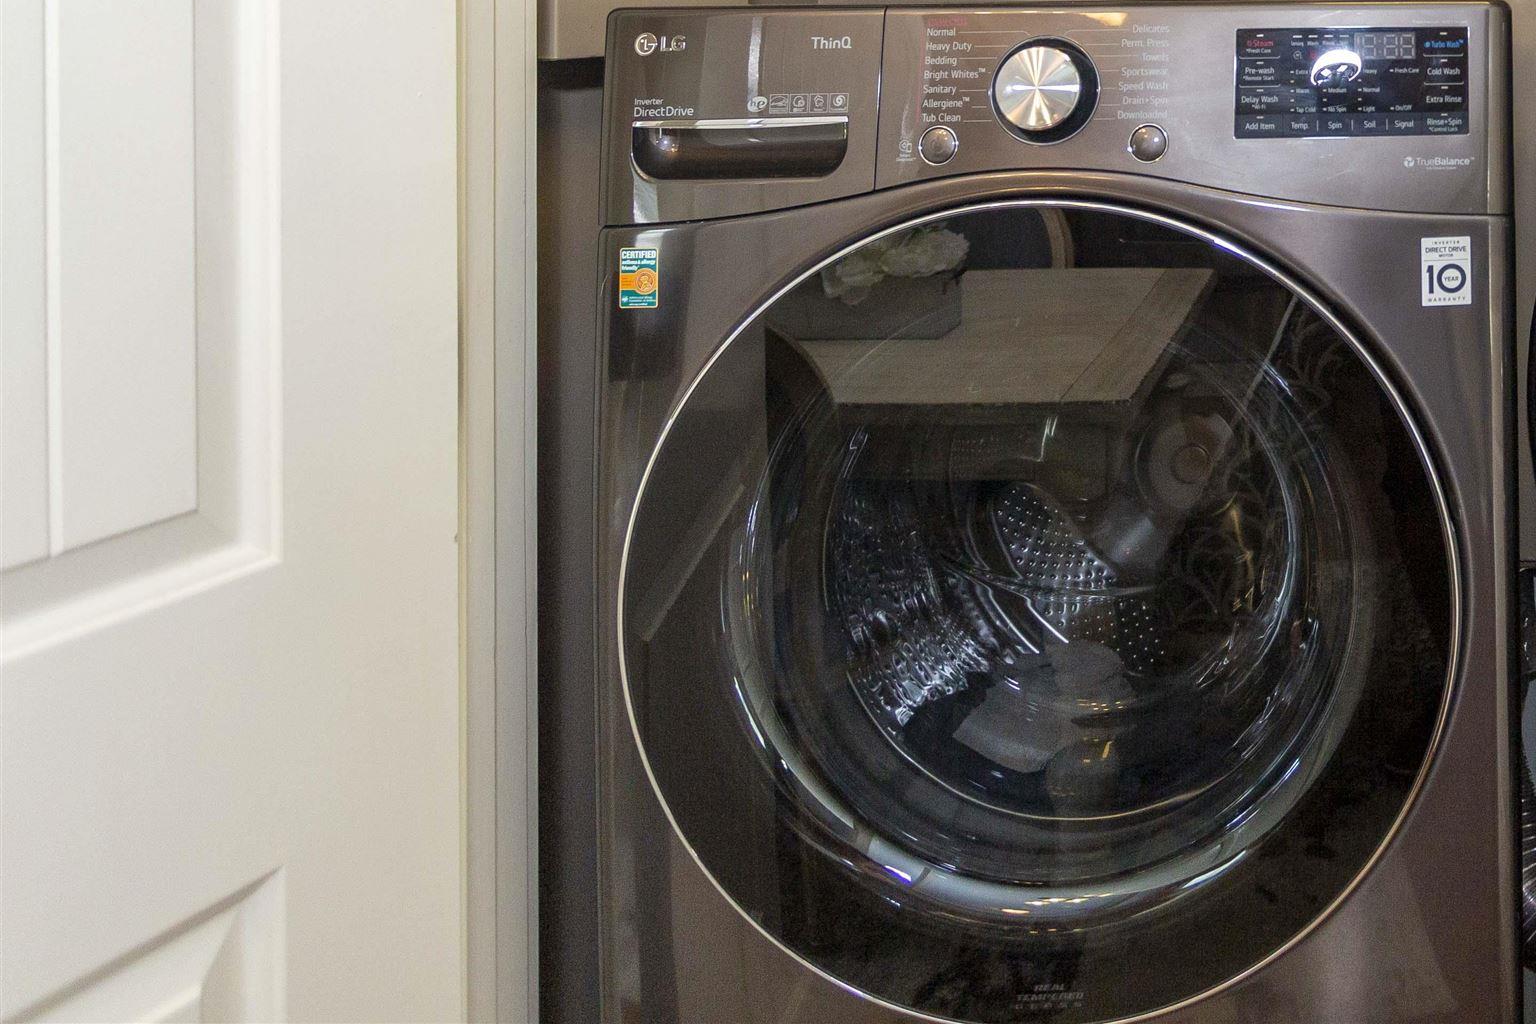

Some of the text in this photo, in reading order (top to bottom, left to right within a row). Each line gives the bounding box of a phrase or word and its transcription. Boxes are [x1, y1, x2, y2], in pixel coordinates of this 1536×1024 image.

[927, 27, 956, 37] Normal
[1132, 24, 1170, 33] Delicates
[659, 35, 686, 52] LG
[811, 36, 852, 49] ThinQ
[926, 41, 972, 52] Heavy Duty
[924, 56, 958, 66] Bedding
[923, 70, 948, 81] Bright
[1121, 66, 1168, 78] Sportswear
[1244, 67, 1275, 75] Pre-wash
[1427, 67, 1460, 75] Cold Wash
[923, 84, 957, 95] Sanitary
[1118, 81, 1168, 92] Speed Wash
[634, 97, 663, 106] Inverter
[1241, 95, 1279, 104] Delay Wash
[1444, 95, 1462, 103] Rinse
[921, 112, 961, 122] Tub Clean
[1117, 110, 1168, 120] Downloaded
[1245, 122, 1275, 130] Add Item
[1327, 121, 1343, 130] Spin
[1363, 120, 1376, 128] Soil
[1394, 120, 1414, 129] Signal
[621, 250, 657, 259] CERTIFIED
[1426, 263, 1467, 294] 10
